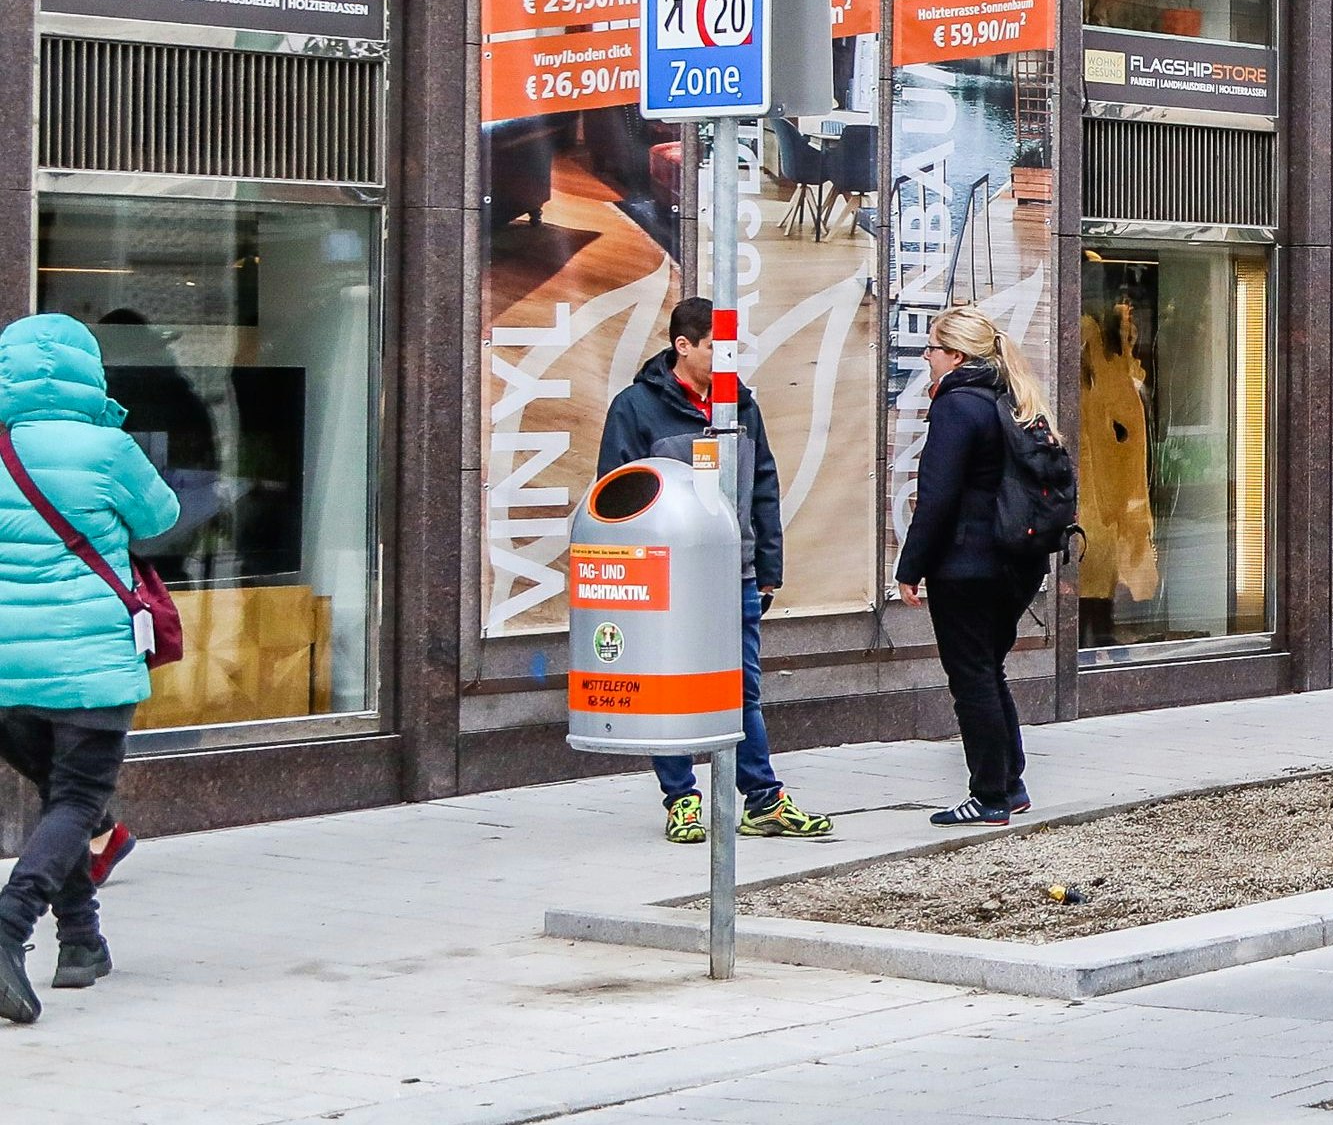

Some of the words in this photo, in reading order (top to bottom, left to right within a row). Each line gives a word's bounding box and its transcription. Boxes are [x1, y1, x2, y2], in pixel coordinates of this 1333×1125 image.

[917, 5, 980, 21] Holzterrasse
[932, 25, 946, 48] €
[533, 47, 606, 68] Vinylboden
[607, 43, 633, 61] click
[1087, 56, 1117, 67] WOHN
[669, 59, 741, 97] Zone
[1087, 65, 1123, 80] GESUND
[1129, 54, 1268, 84] FLAGSHIPSTORE
[524, 76, 538, 101] €
[489, 302, 572, 633] VINYL
[578, 562, 600, 580] TAG-
[600, 562, 626, 581] UND
[578, 584, 650, 602] NACHTAKTIV.
[582, 679, 641, 693] MISTTELEFON
